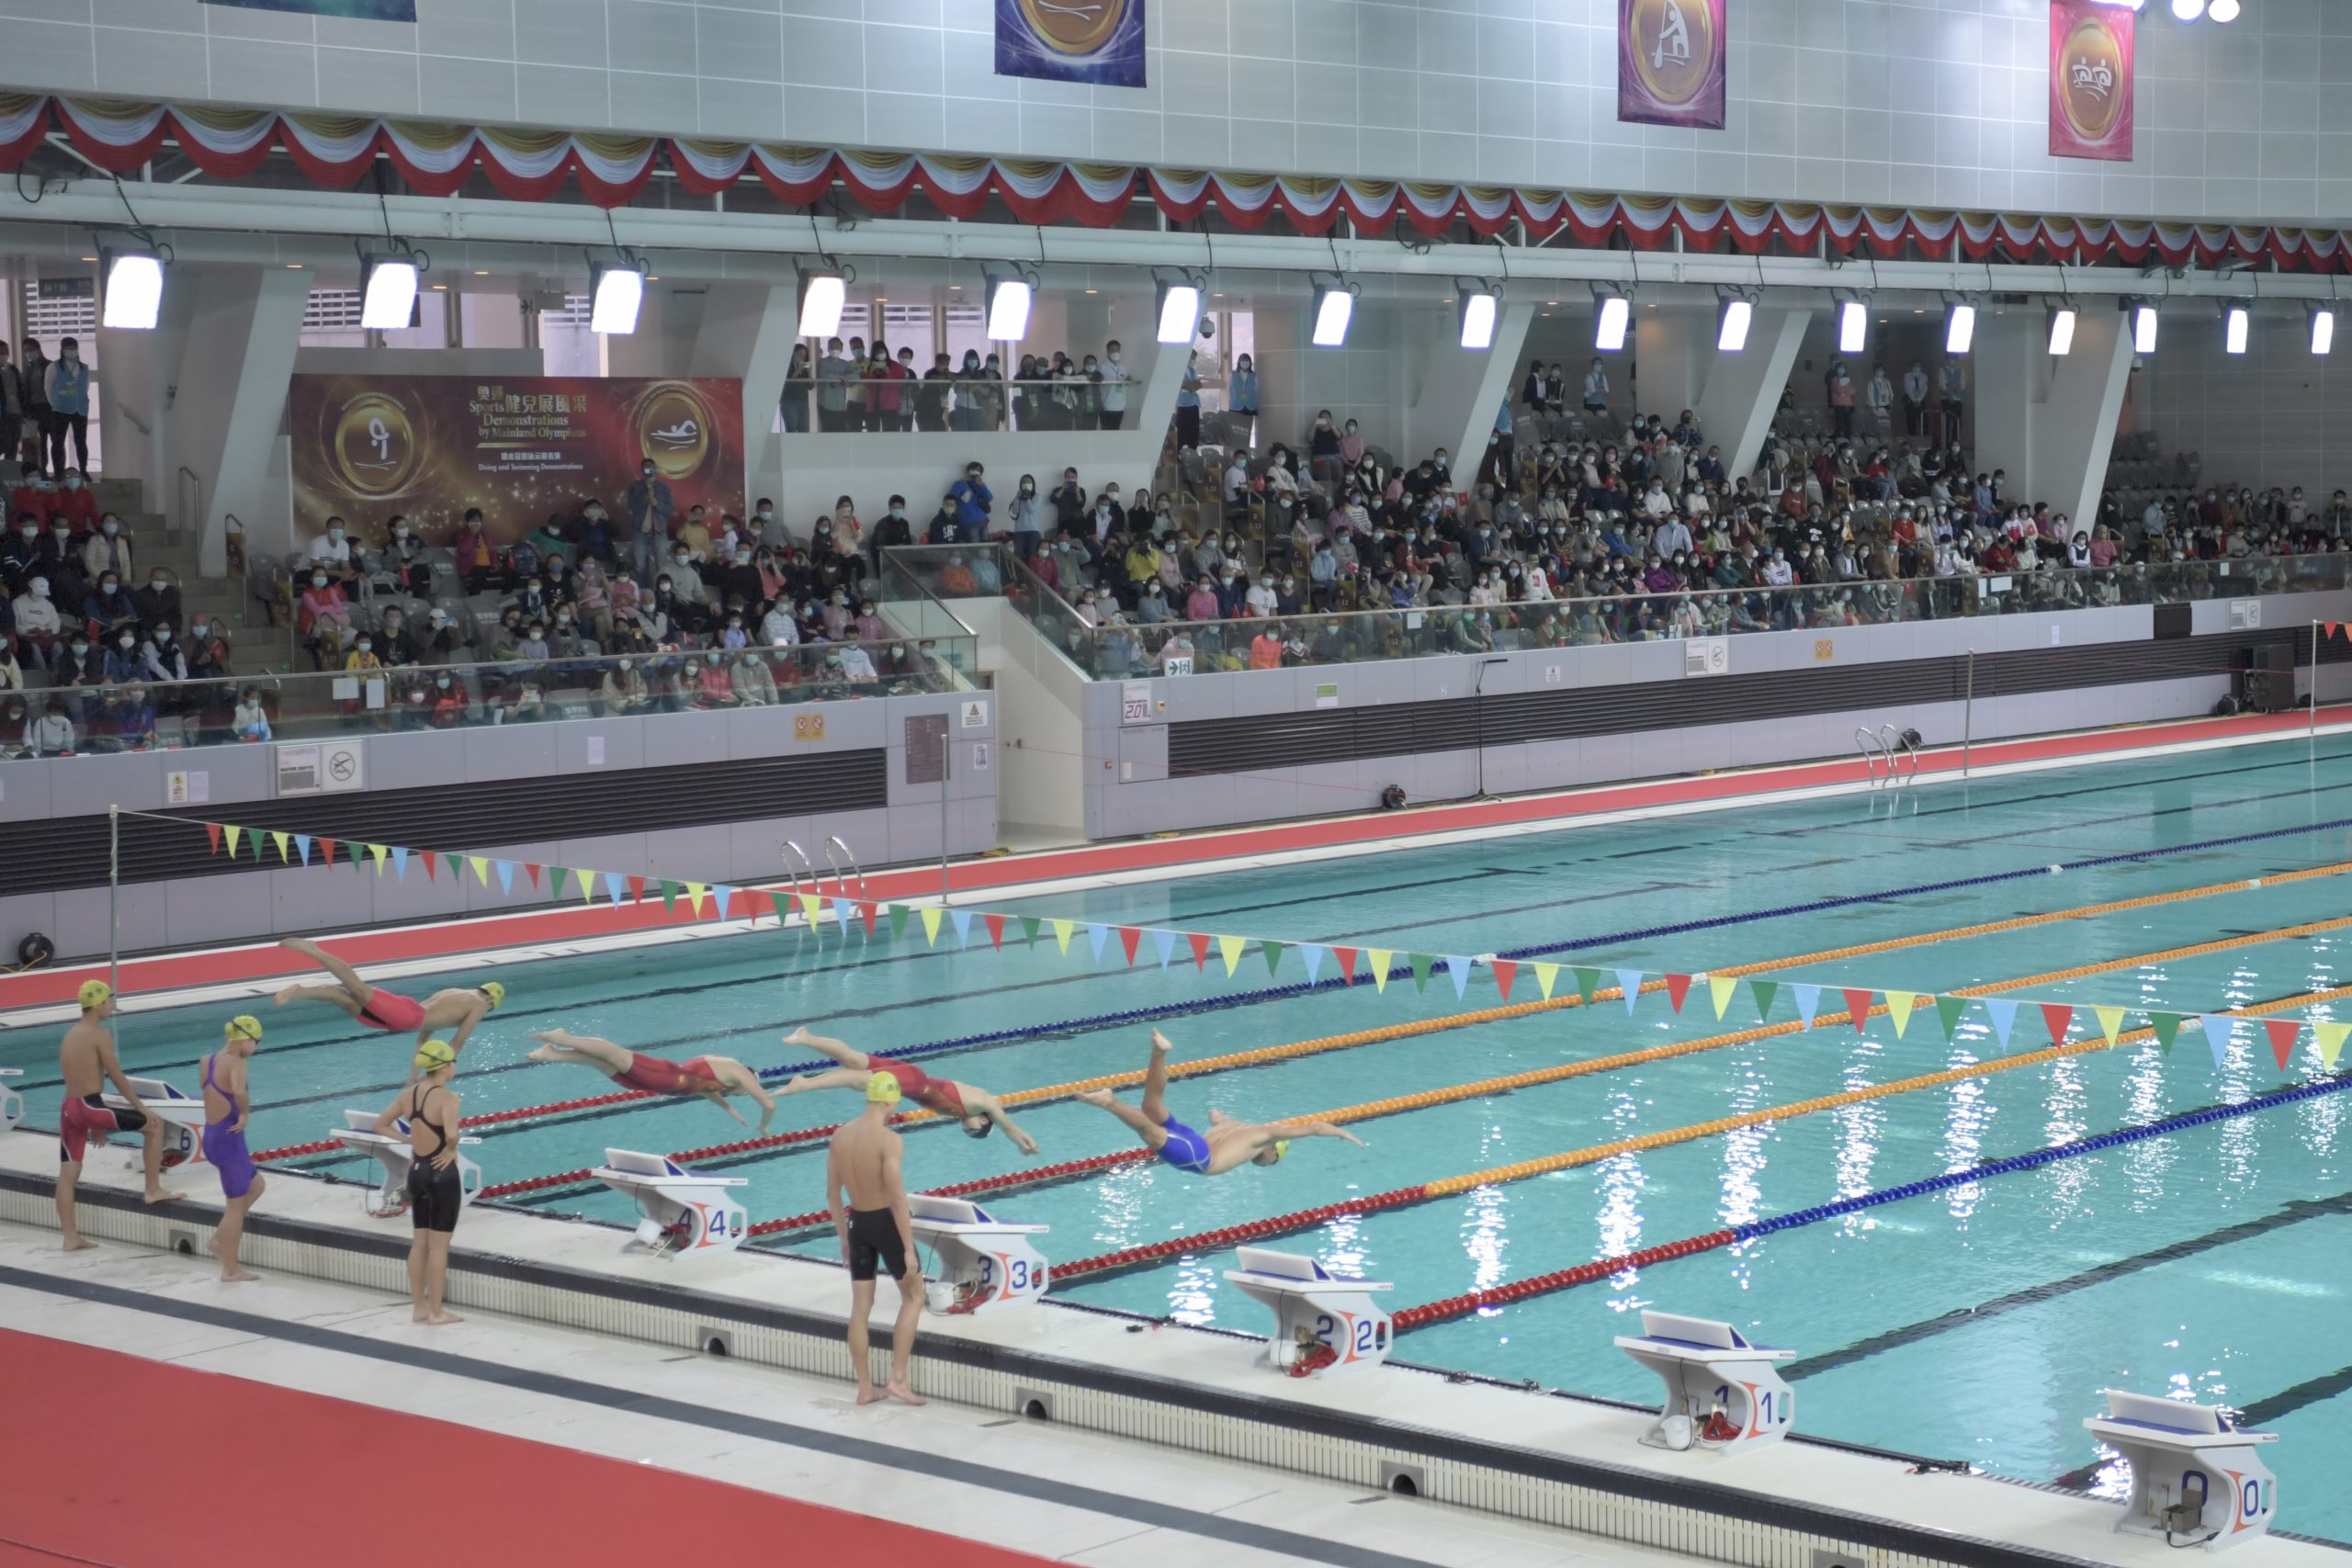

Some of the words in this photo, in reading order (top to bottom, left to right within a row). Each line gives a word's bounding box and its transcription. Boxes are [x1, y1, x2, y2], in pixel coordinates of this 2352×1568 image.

[469, 400, 504, 416] Sports
[506, 394, 587, 412] 健兒展風采
[483, 412, 569, 426] Demonstrations
[479, 426, 490, 439] by
[492, 427, 537, 437] Mainland
[538, 427, 586, 440] Olympians
[180, 1127, 191, 1151] 6
[708, 1210, 726, 1236] 4
[978, 1256, 992, 1284] 3
[1012, 1260, 1028, 1290] 3
[1357, 1320, 1372, 1351] 2
[1761, 1392, 1771, 1424] 1
[2244, 1479, 2258, 1517] 0
